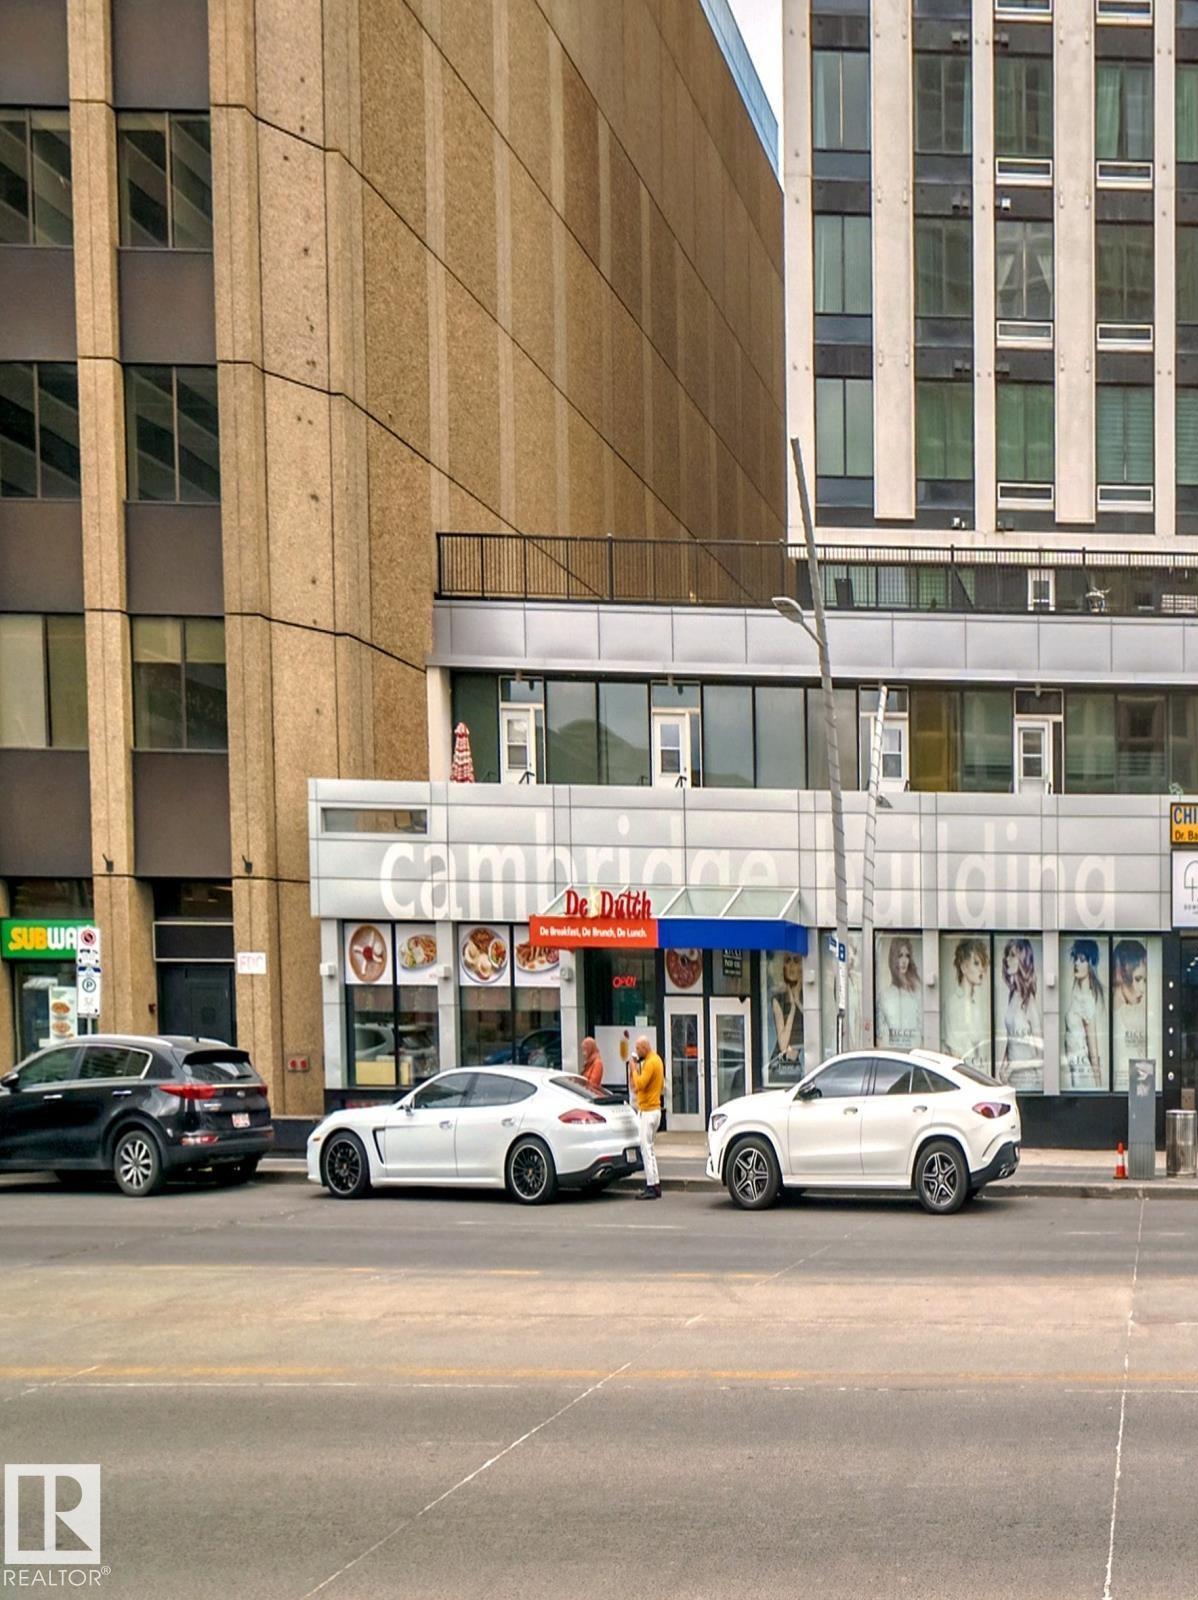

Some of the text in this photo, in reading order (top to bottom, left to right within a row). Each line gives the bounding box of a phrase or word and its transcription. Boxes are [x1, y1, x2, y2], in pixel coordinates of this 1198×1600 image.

[1174, 830, 1186, 840] Dr.
[565, 890, 652, 920] De Dutch
[8, 927, 77, 951] SUBWA
